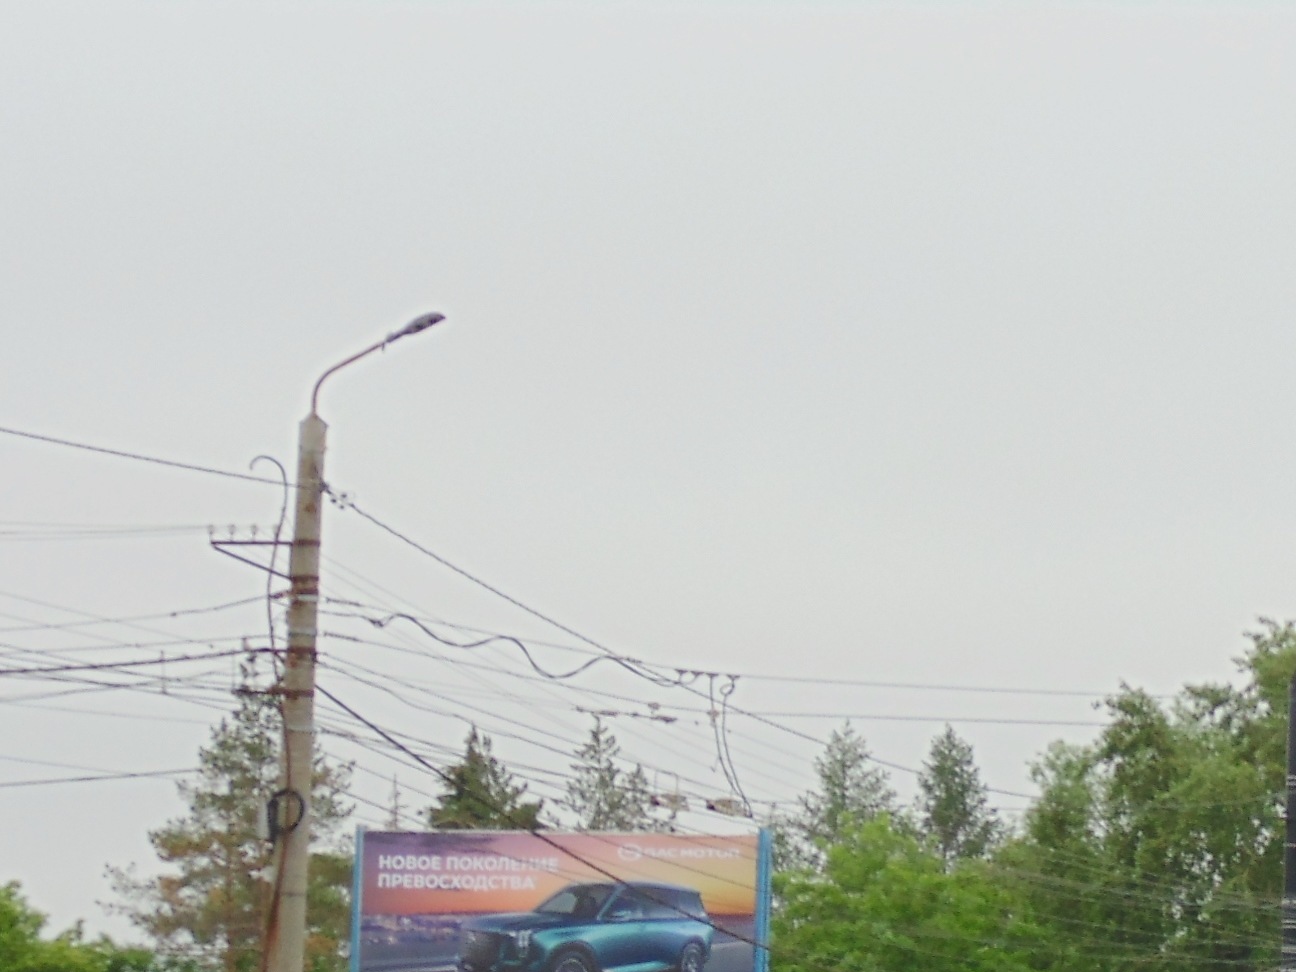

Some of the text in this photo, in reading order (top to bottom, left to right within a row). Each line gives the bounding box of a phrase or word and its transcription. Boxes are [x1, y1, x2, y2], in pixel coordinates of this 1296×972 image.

[378, 854, 560, 873] НОВОЕ ПОКОЛЕНИЕ
[377, 873, 536, 891] ПРЕВОСХОДСТВА
